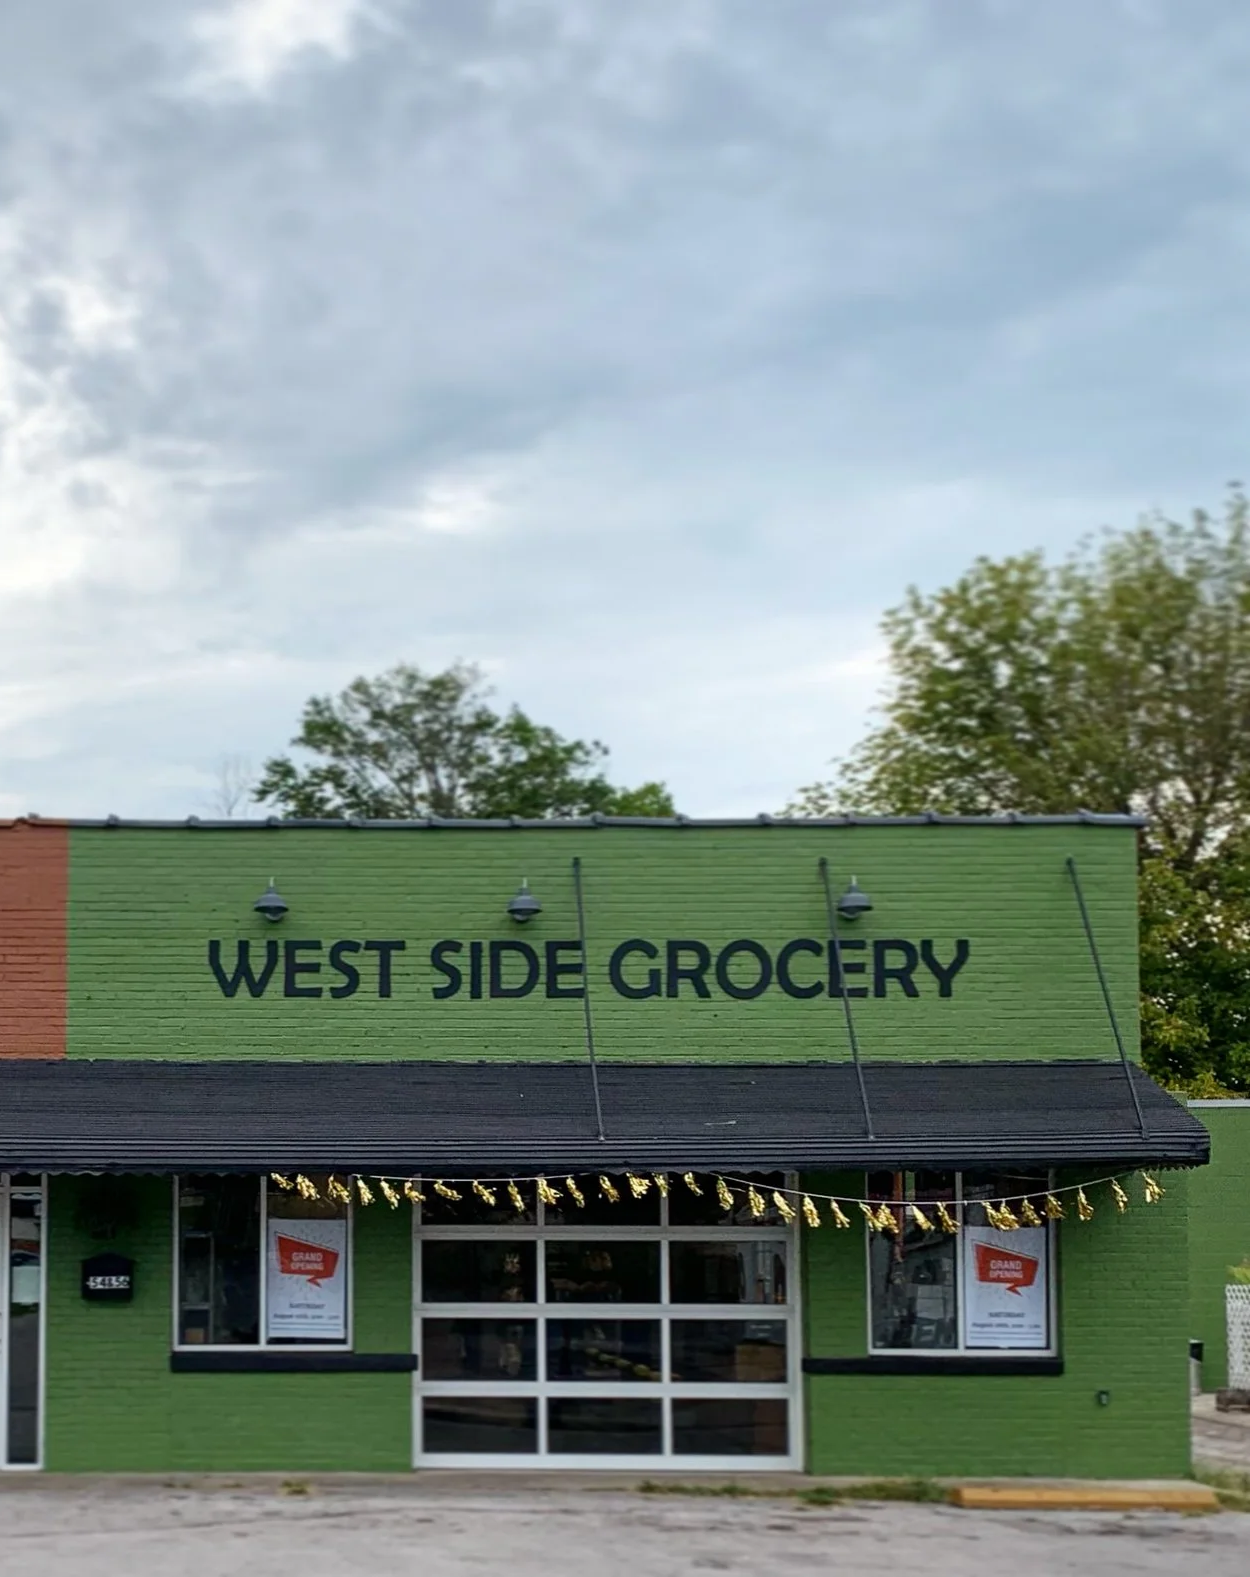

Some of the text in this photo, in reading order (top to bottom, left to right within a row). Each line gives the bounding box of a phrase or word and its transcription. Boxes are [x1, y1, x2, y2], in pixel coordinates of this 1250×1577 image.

[208, 939, 969, 999] WEST SIDE GROCERY
[292, 1252, 323, 1262] GRAND
[291, 1262, 324, 1271] OPENING
[990, 1260, 1022, 1270] GRAND
[989, 1270, 1023, 1279] OPENING
